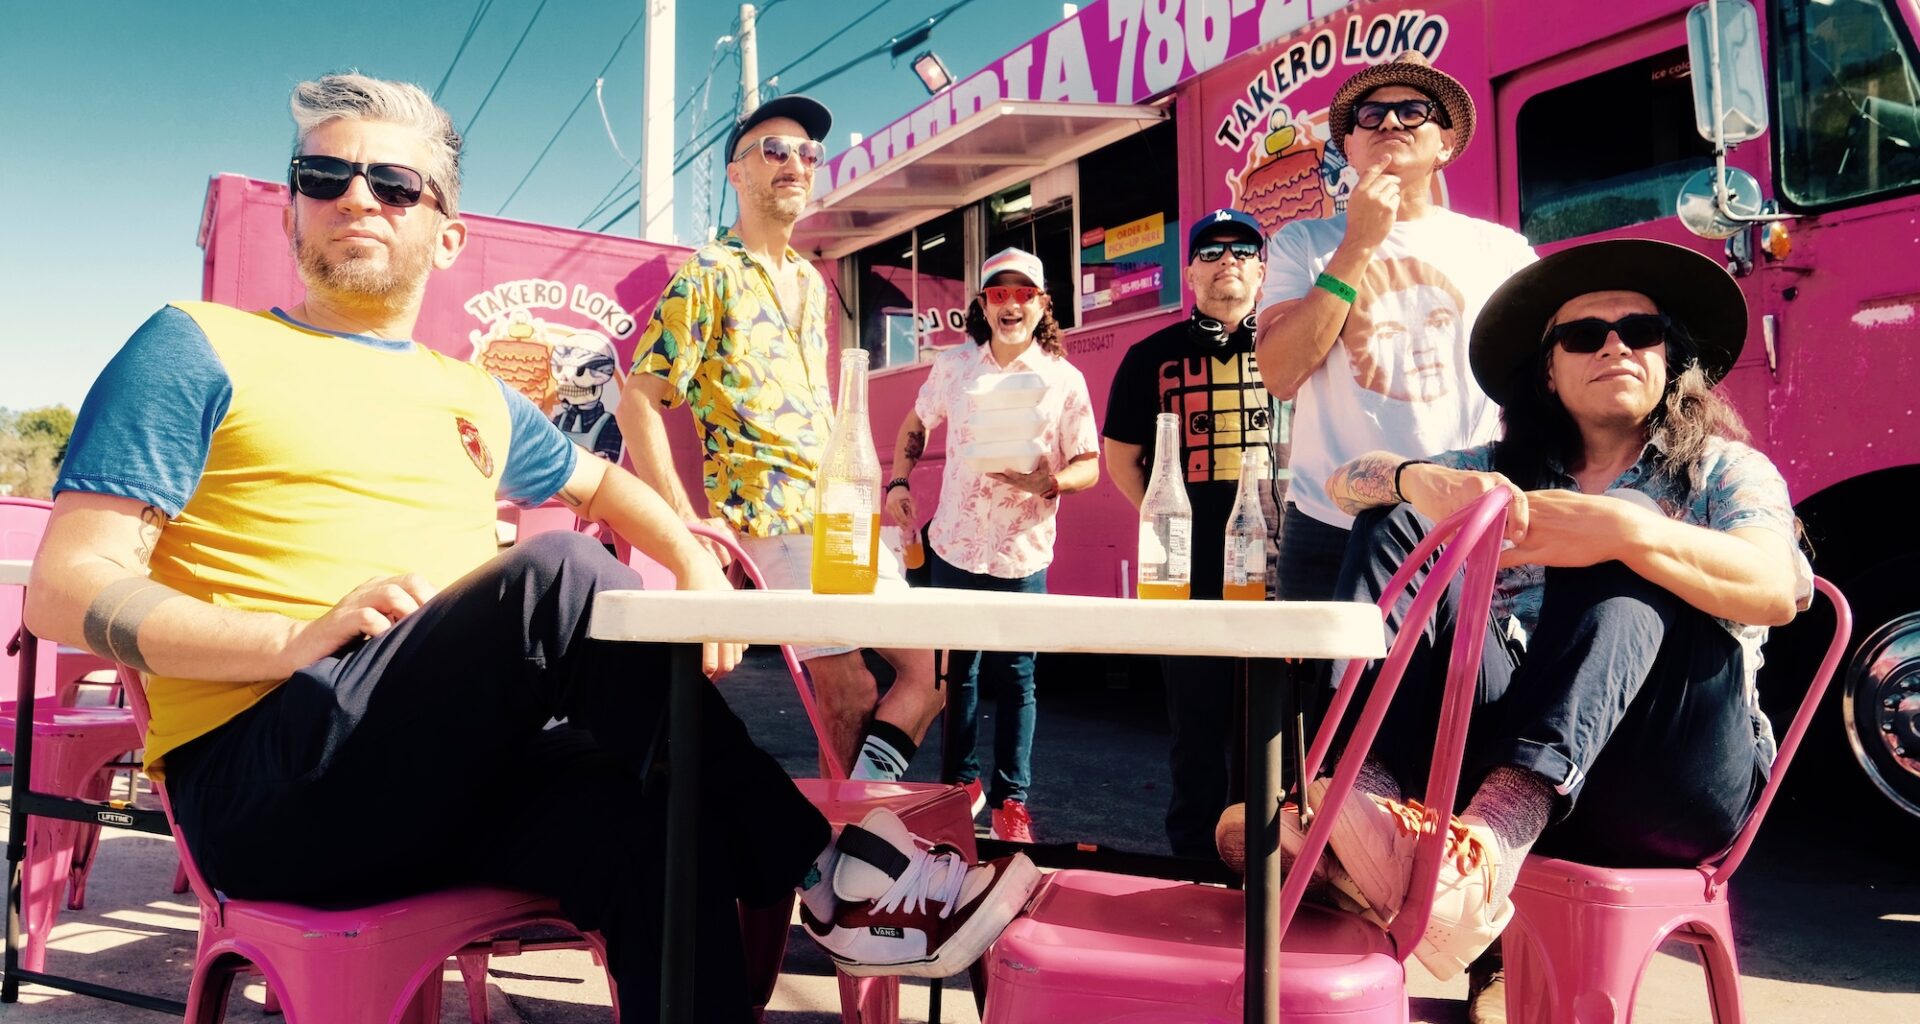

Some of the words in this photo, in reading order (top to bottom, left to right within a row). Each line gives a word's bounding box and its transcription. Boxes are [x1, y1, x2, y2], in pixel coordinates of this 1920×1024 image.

[1217, 33, 1333, 148] TAKERO
[1344, 14, 1443, 59] LOKO
[1651, 70, 1667, 80] ice
[1214, 208, 1232, 222] LA
[1116, 224, 1141, 240] ORDER
[1143, 222, 1151, 232] &
[1108, 236, 1140, 255] PICK-UP
[1141, 230, 1161, 243] HERE
[469, 282, 564, 319] TAKERO
[574, 288, 634, 336] LOKO
[101, 813, 129, 823] LIFETIME
[873, 926, 896, 937] VANS
